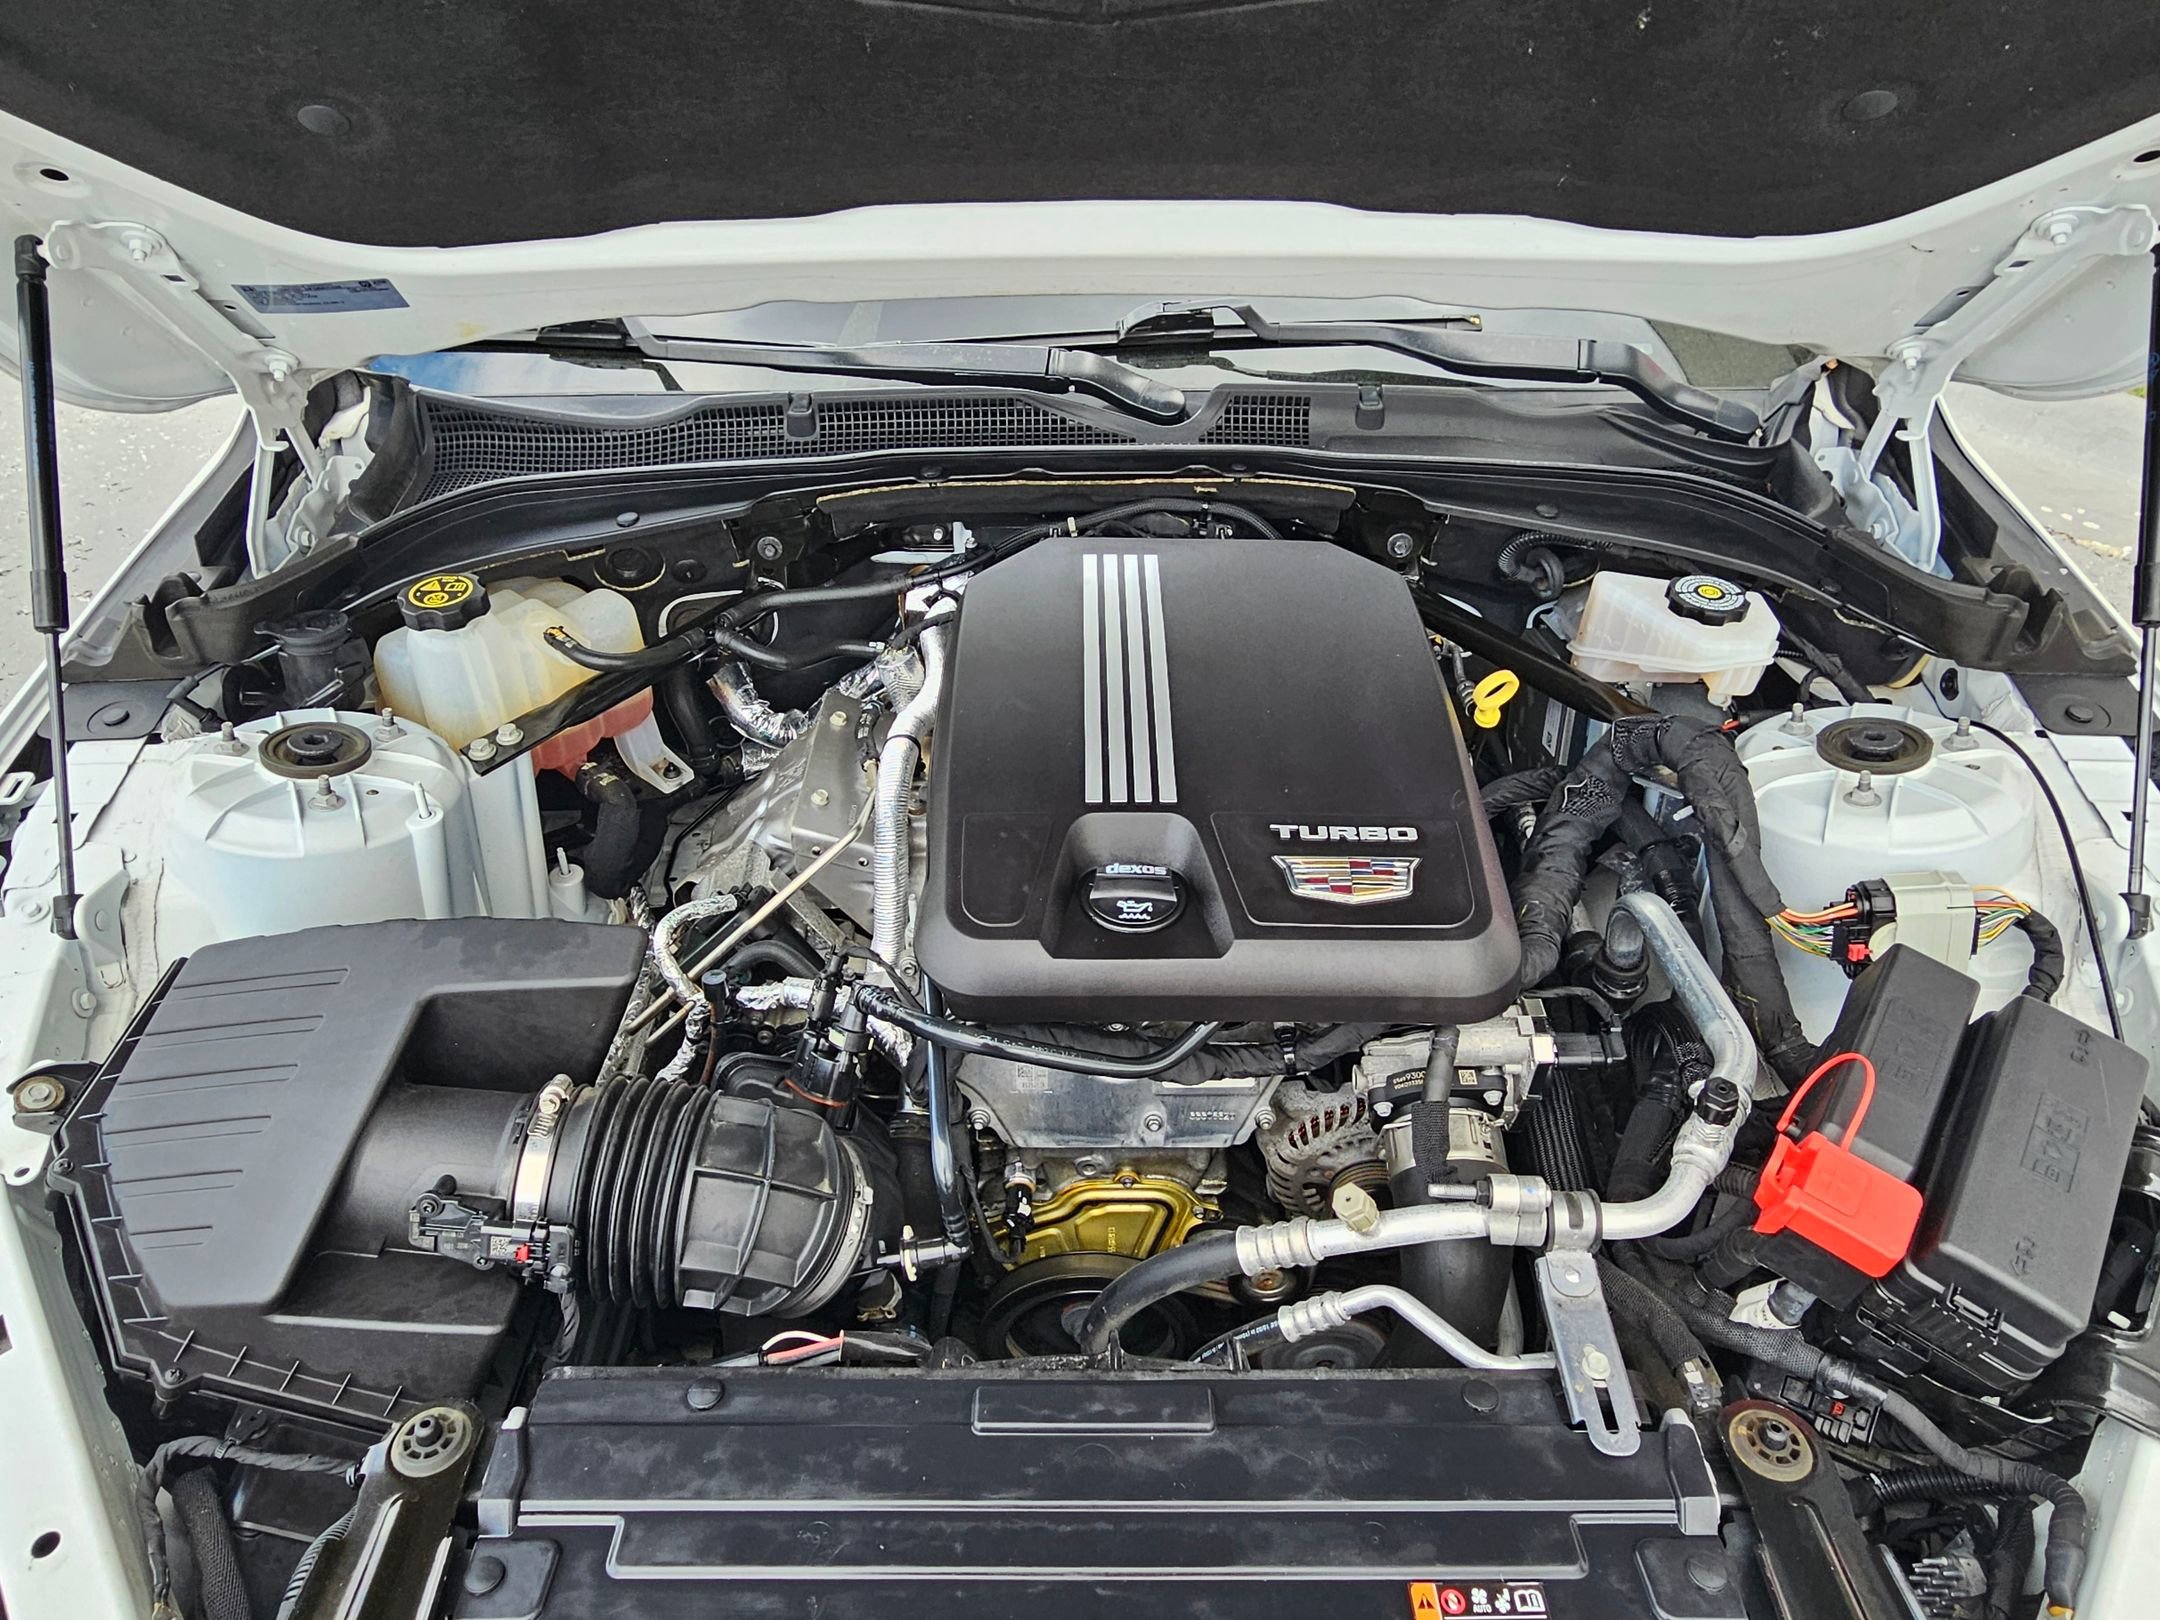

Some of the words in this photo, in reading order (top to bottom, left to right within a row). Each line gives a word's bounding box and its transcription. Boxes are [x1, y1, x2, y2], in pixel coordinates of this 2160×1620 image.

[1269, 823, 1419, 843] TURBO
[1105, 862, 1168, 876] dexos
[1472, 1604, 1493, 1614] AUTO
